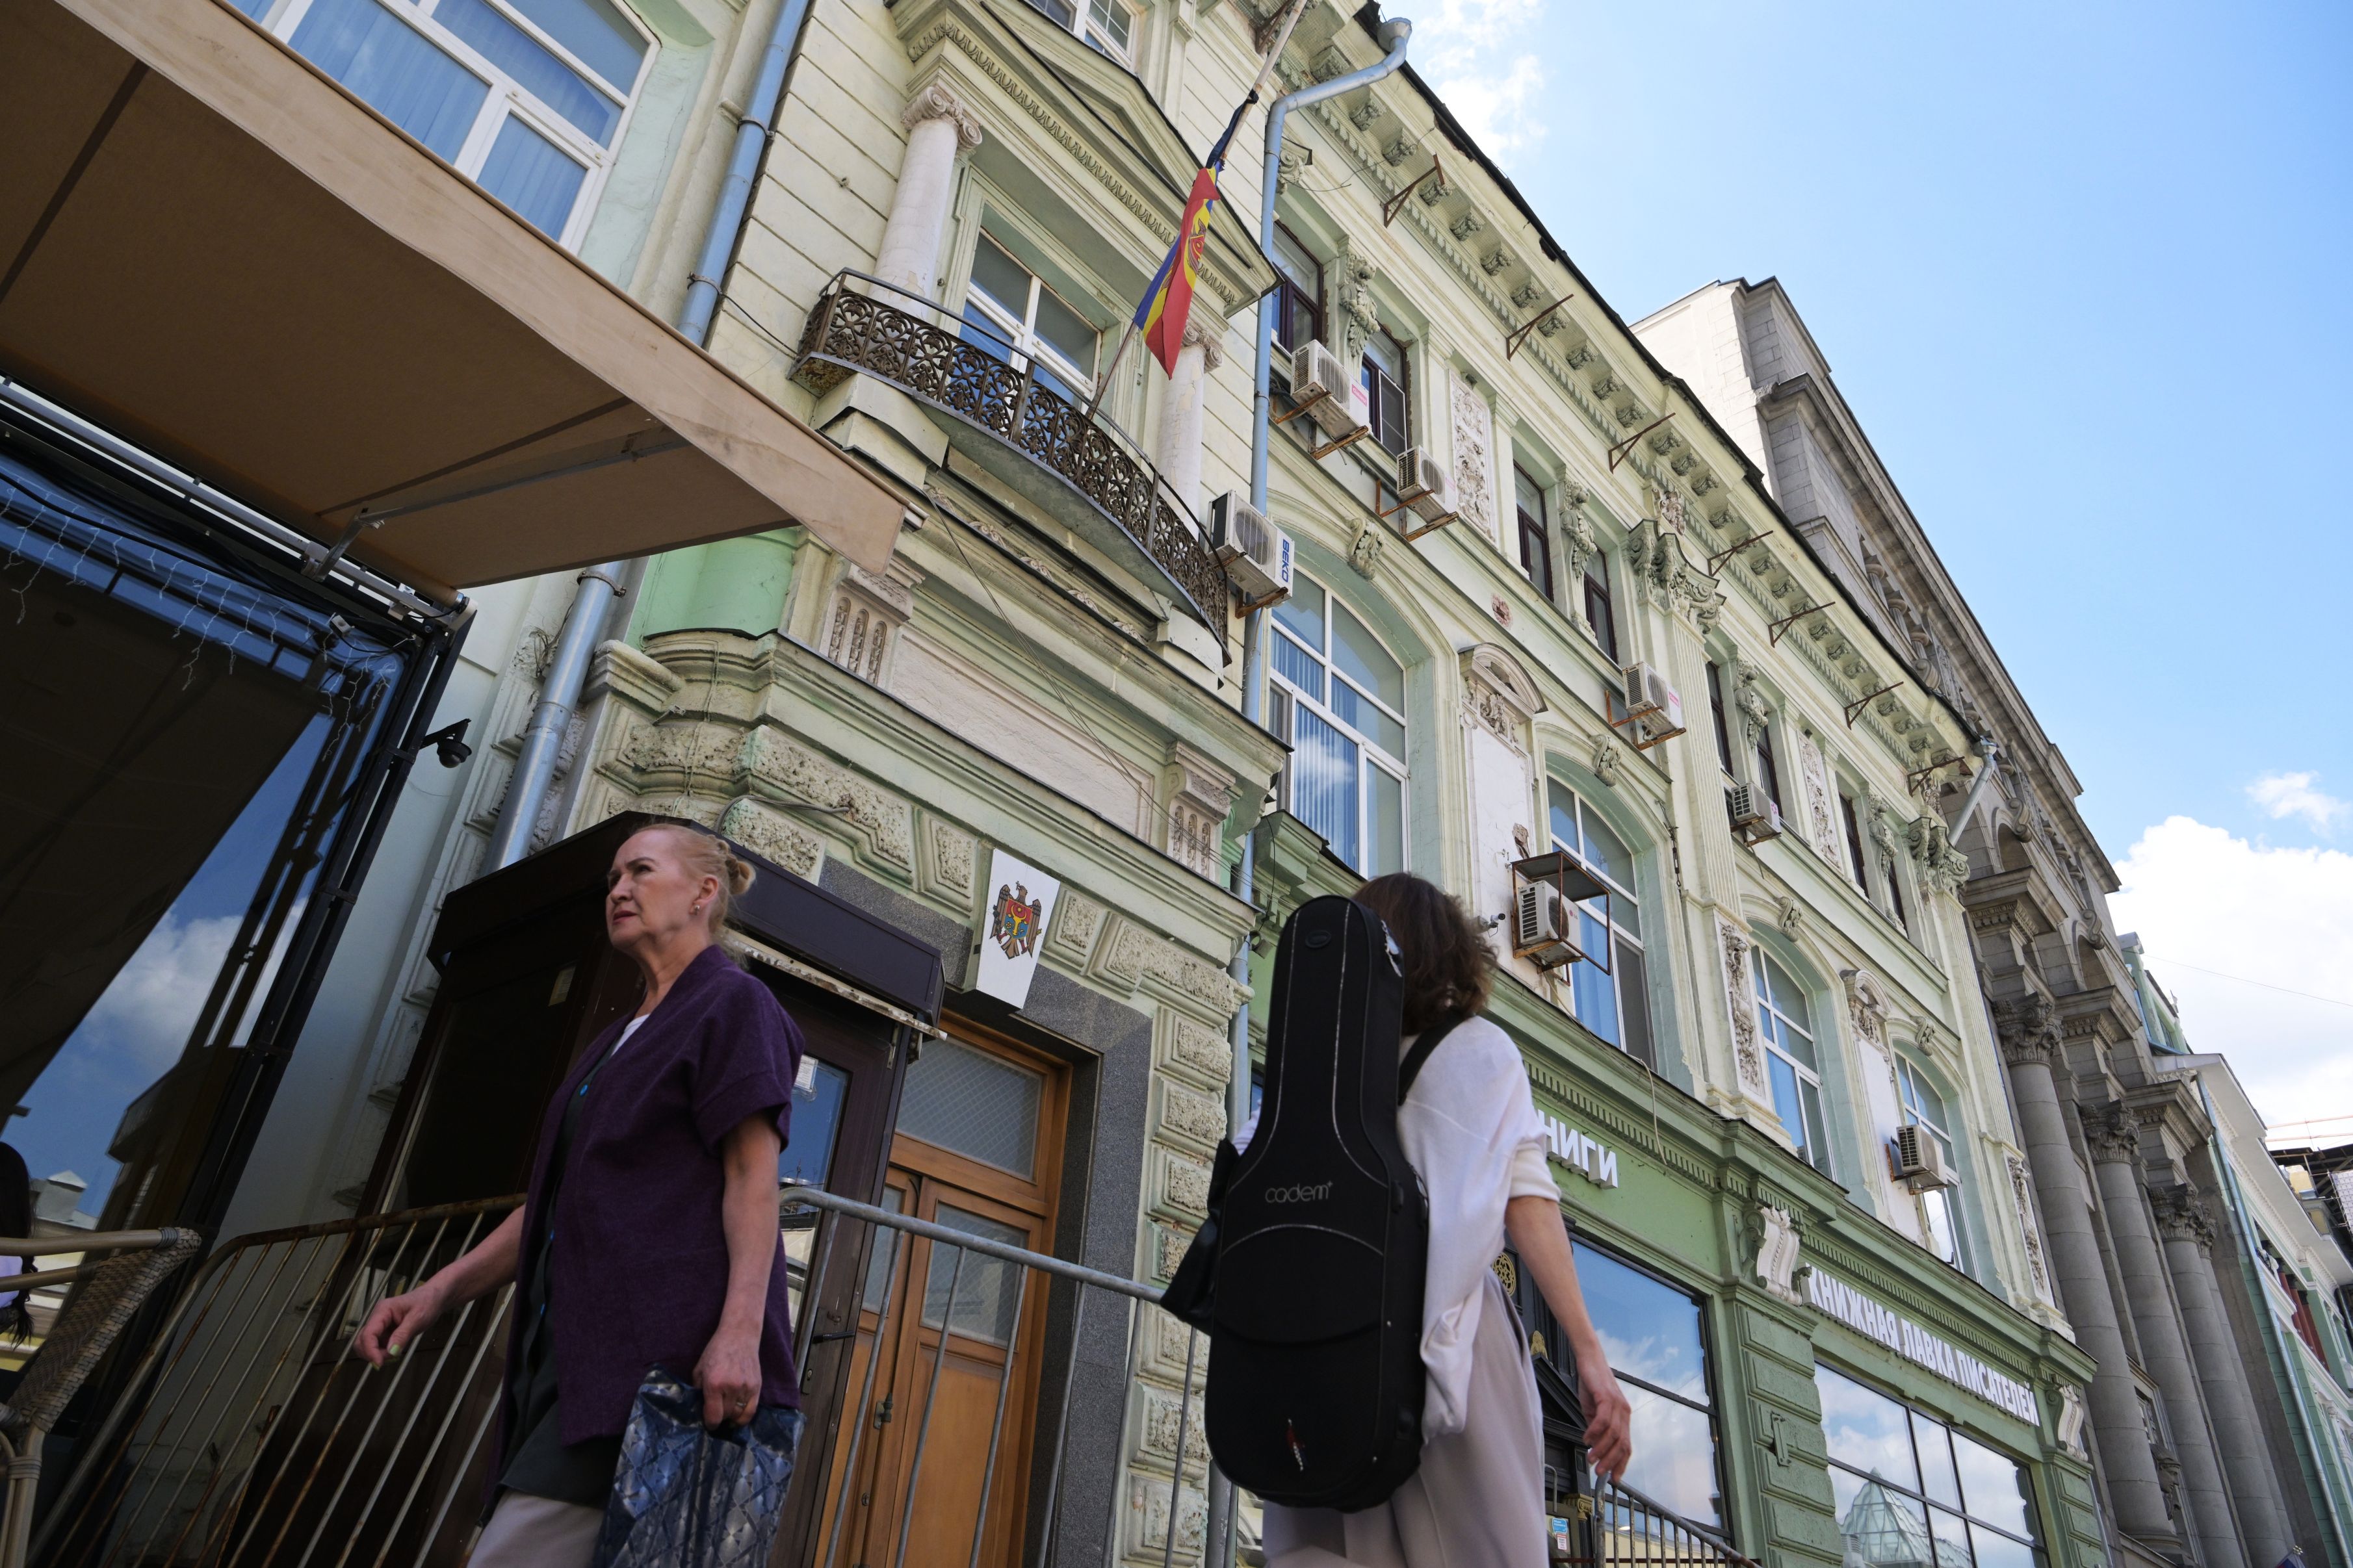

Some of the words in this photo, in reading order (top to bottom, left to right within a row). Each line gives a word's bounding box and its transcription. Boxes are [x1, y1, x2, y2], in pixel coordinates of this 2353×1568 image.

[1538, 1109, 1618, 1189] НИГИ
[1806, 1262, 1901, 1353] КНИЖНАЯ
[1901, 1318, 1959, 1383] ЛАВКА
[1956, 1348, 2040, 1427] ПИСАТЕЛЕЙ
